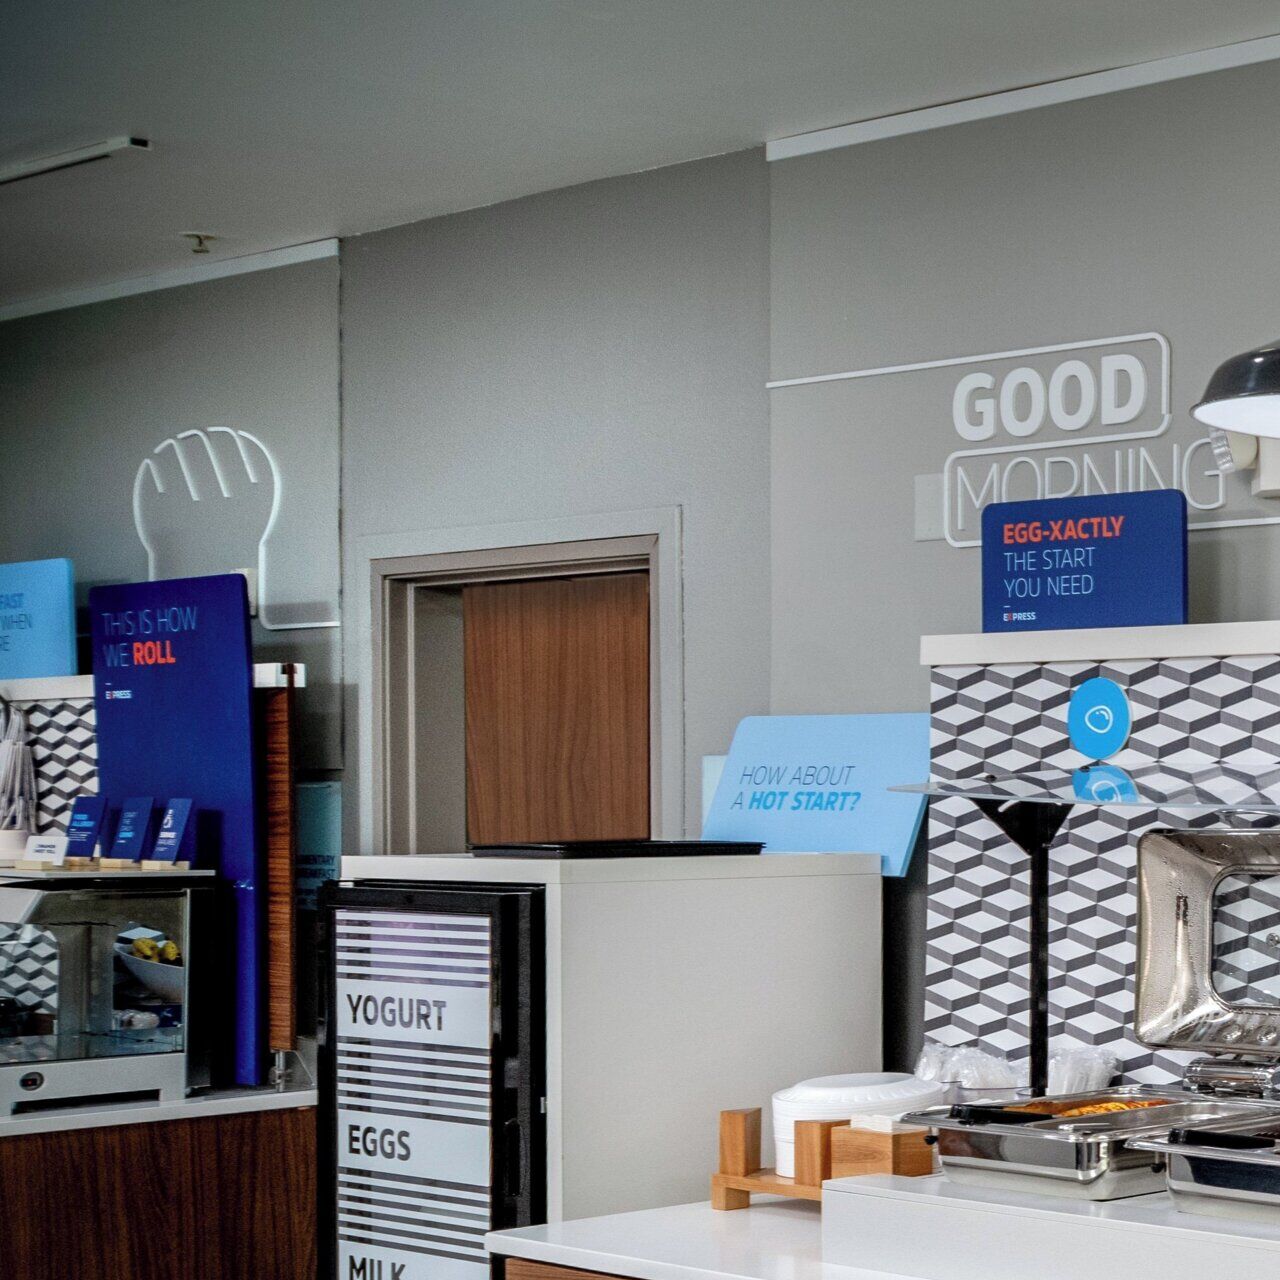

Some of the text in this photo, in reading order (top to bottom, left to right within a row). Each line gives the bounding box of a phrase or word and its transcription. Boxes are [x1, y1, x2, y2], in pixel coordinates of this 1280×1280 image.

[952, 354, 1148, 442] GOOD
[1003, 516, 1125, 545] EGG-XACTLY
[1003, 547, 1096, 572] THE START
[1004, 574, 1094, 598] YOU NEED
[101, 606, 198, 636] THIS IS HOW
[1003, 611, 1036, 622] EXPRESS
[103, 640, 176, 668] WE ROLL
[739, 765, 856, 785] HOW ABOUT
[730, 791, 862, 811] A HOT START?
[346, 993, 447, 1031] YOGURT
[348, 1124, 412, 1162] EGGS
